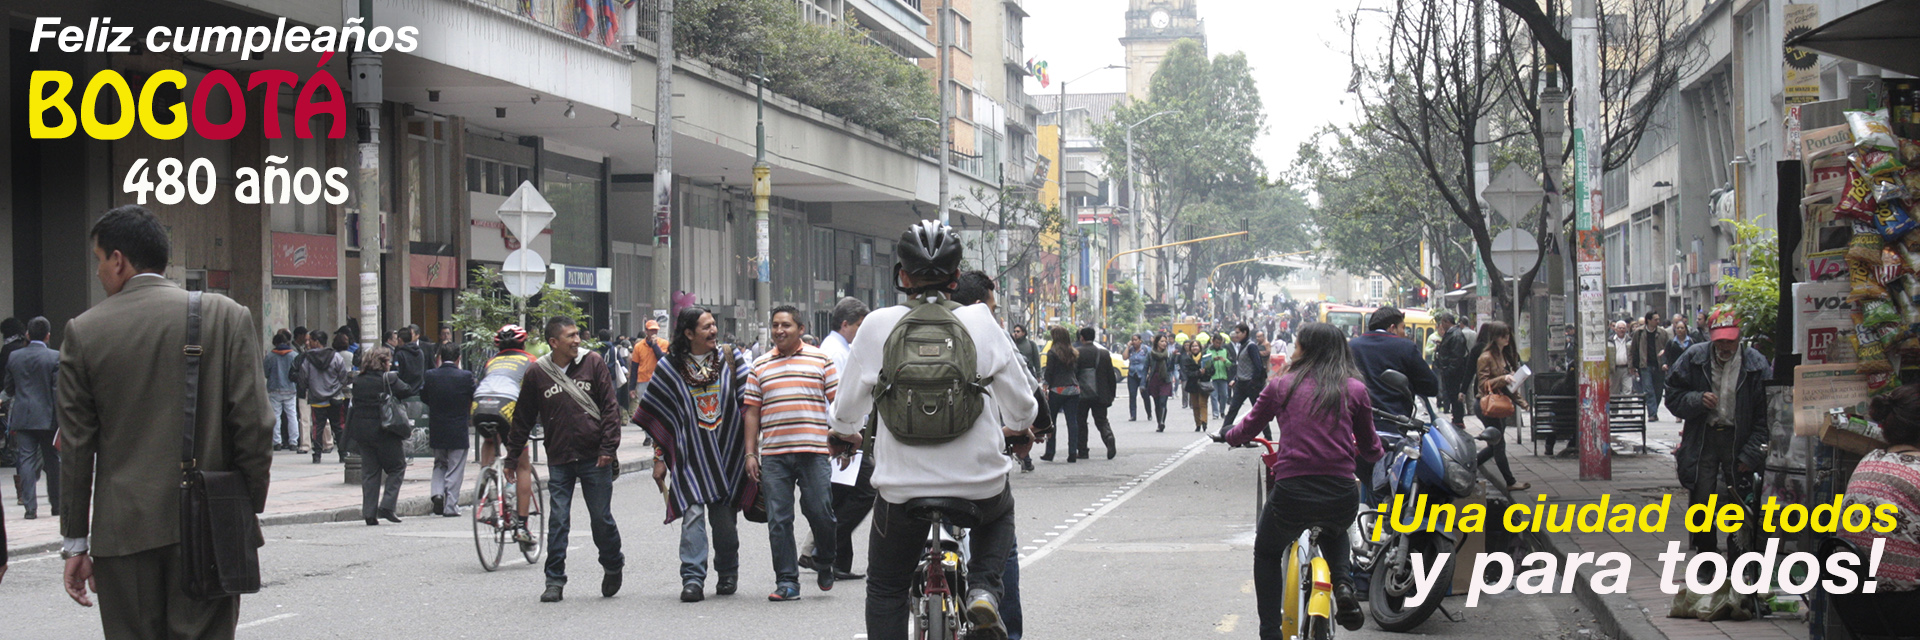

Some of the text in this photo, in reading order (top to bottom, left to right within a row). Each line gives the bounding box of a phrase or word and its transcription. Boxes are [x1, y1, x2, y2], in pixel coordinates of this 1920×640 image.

[1806, 129, 1850, 151] Portafo
[568, 271, 594, 287] PATPRIMO
[1813, 296, 1852, 310] VOZ
[1810, 332, 1834, 349] LR
[544, 379, 592, 399] adias
